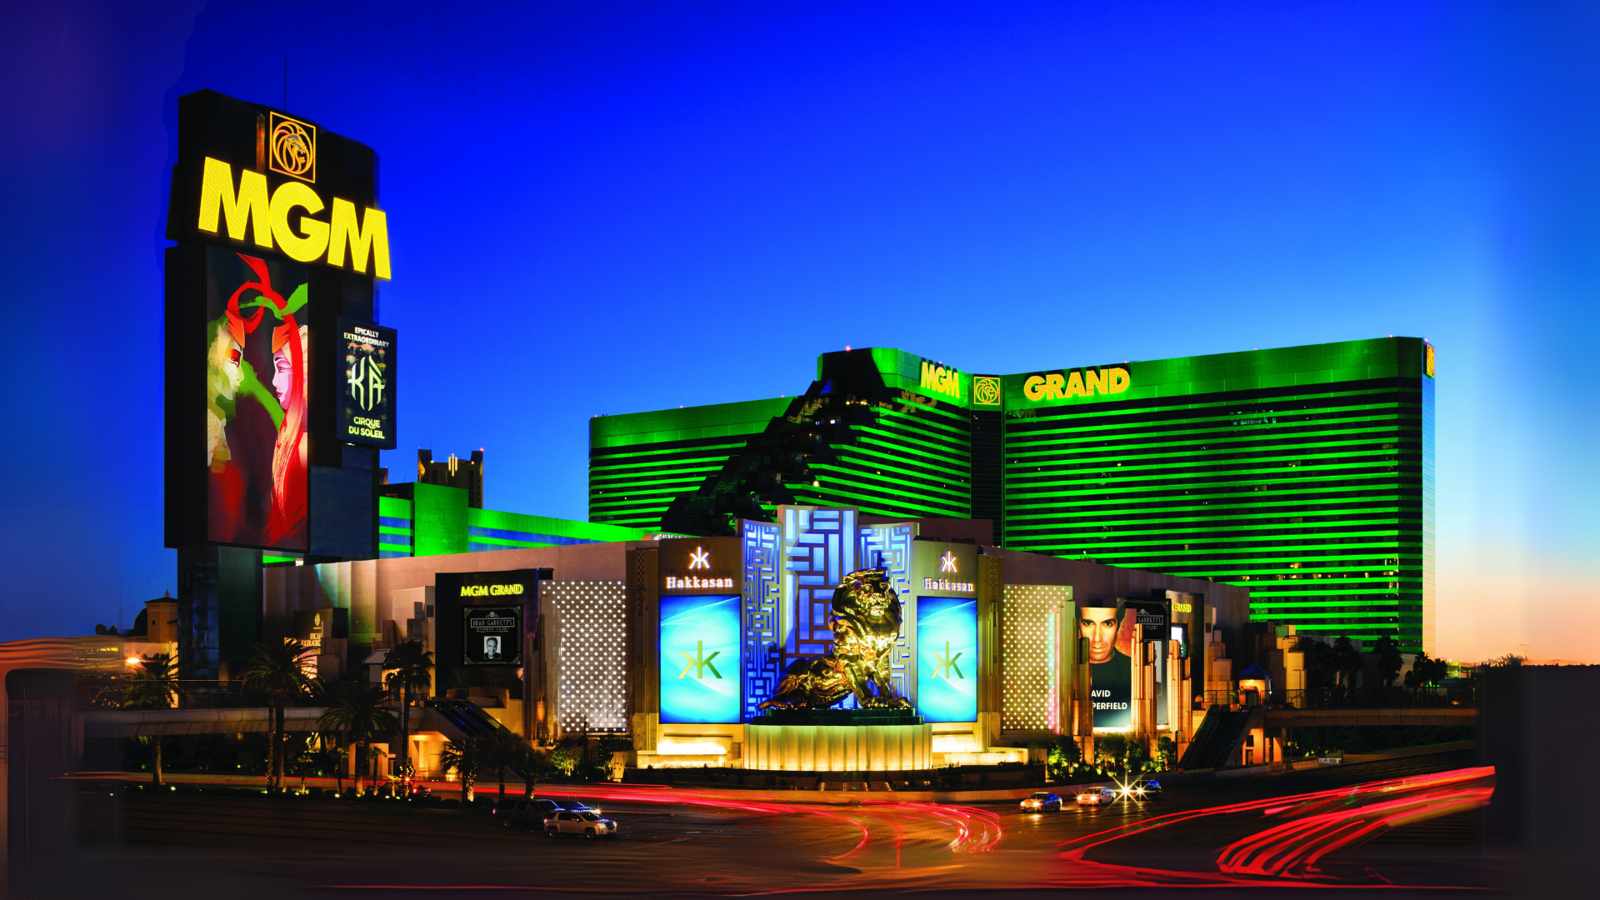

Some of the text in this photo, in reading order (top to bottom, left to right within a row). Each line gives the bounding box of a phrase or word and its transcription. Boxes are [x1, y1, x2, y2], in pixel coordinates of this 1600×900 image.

[198, 156, 392, 281] MGM
[354, 326, 380, 338] EPICALLY
[343, 332, 390, 348] EXTRAORDINARY
[920, 361, 960, 399] MGM
[1023, 366, 1131, 402] GRAND
[353, 416, 381, 430] CIRQUE
[348, 425, 385, 439] DU SOLEIL
[666, 575, 734, 589] Hakkasan
[922, 576, 975, 592] Hakkasan
[460, 584, 524, 597] MGM GRAND
[1091, 689, 1111, 698] AVID
[1092, 702, 1128, 710] PERFIELD
